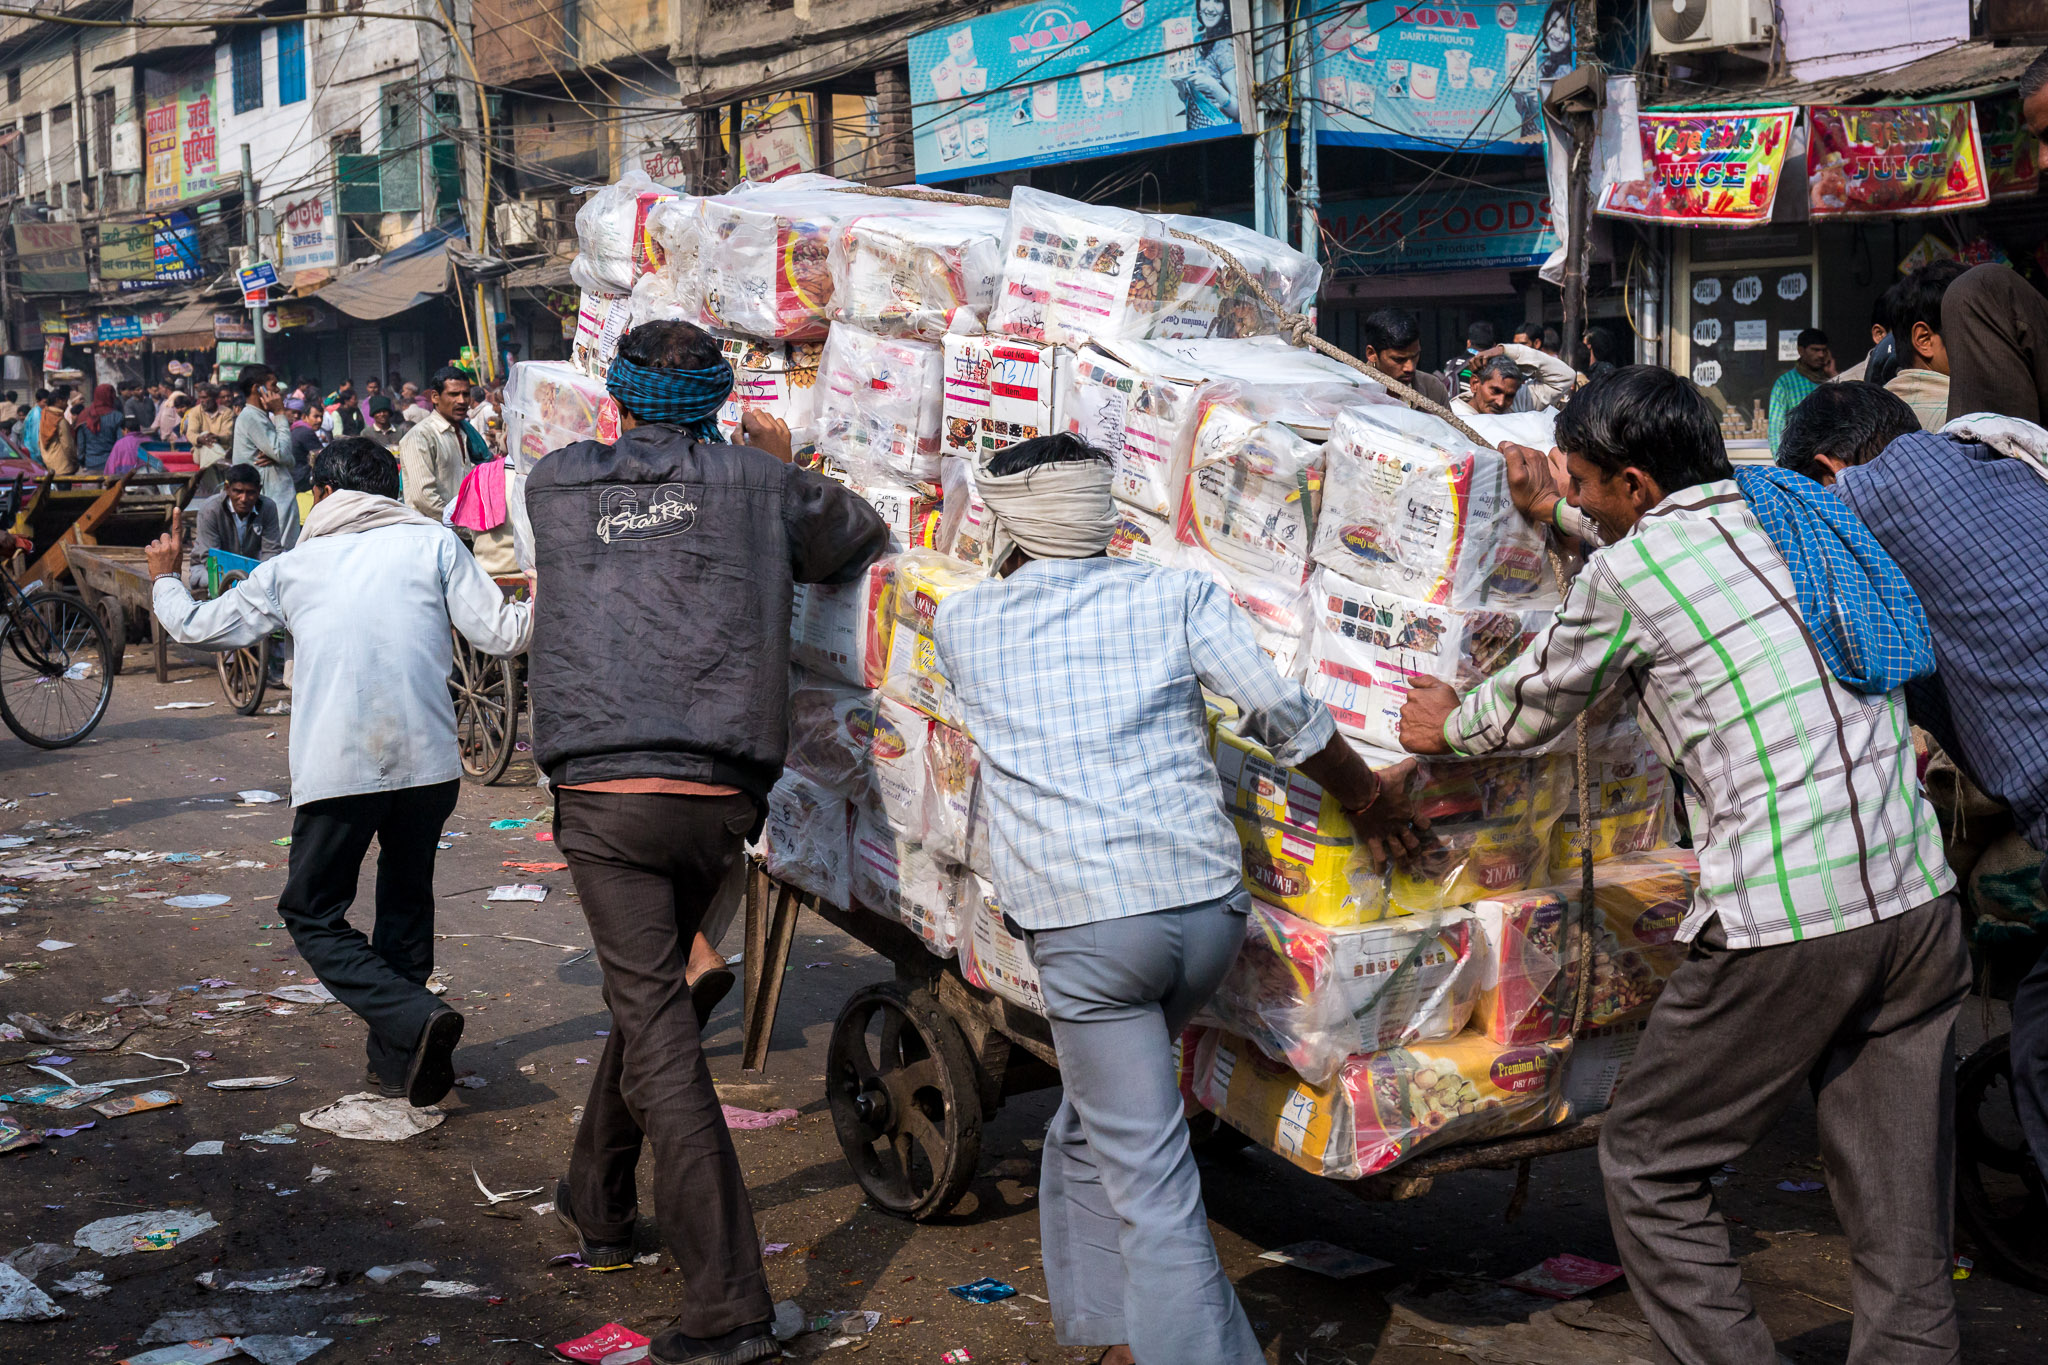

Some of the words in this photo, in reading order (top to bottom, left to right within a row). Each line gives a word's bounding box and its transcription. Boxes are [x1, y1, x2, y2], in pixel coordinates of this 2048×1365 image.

[1394, 6, 1480, 29] NOVA
[1009, 20, 1092, 53] NOVA
[1400, 31, 1427, 41] DAIRY
[1429, 33, 1475, 46] PRODUCTS
[1017, 55, 1042, 68] DAIRY
[1044, 45, 1090, 61] PRODUCTS
[1656, 123, 1754, 157] Vegetable
[1659, 162, 1748, 188] JUICE
[1853, 153, 1948, 181] JUICE
[1294, 210, 1403, 243] MAR
[1418, 198, 1552, 236] FOODS
[293, 232, 322, 247] SPICES
[1406, 245, 1432, 258] Dairy
[1436, 242, 1486, 256] Products
[1696, 282, 1716, 298] SPECIAL
[1736, 281, 1757, 298] HING
[1781, 279, 1801, 295] POWDER
[268, 313, 277, 328] 3
[1696, 322, 1716, 340] HING
[1003, 350, 1014, 358] Lot
[1015, 351, 1025, 359] No.
[1697, 366, 1716, 382] POWDER
[1005, 386, 1022, 397] Item.
[1381, 708, 1399, 719] Quality
[880, 727, 903, 751] Quality
[1642, 914, 1676, 932] Premium
[1498, 1058, 1534, 1078] Premium
[1512, 1077, 1527, 1090] DRY
